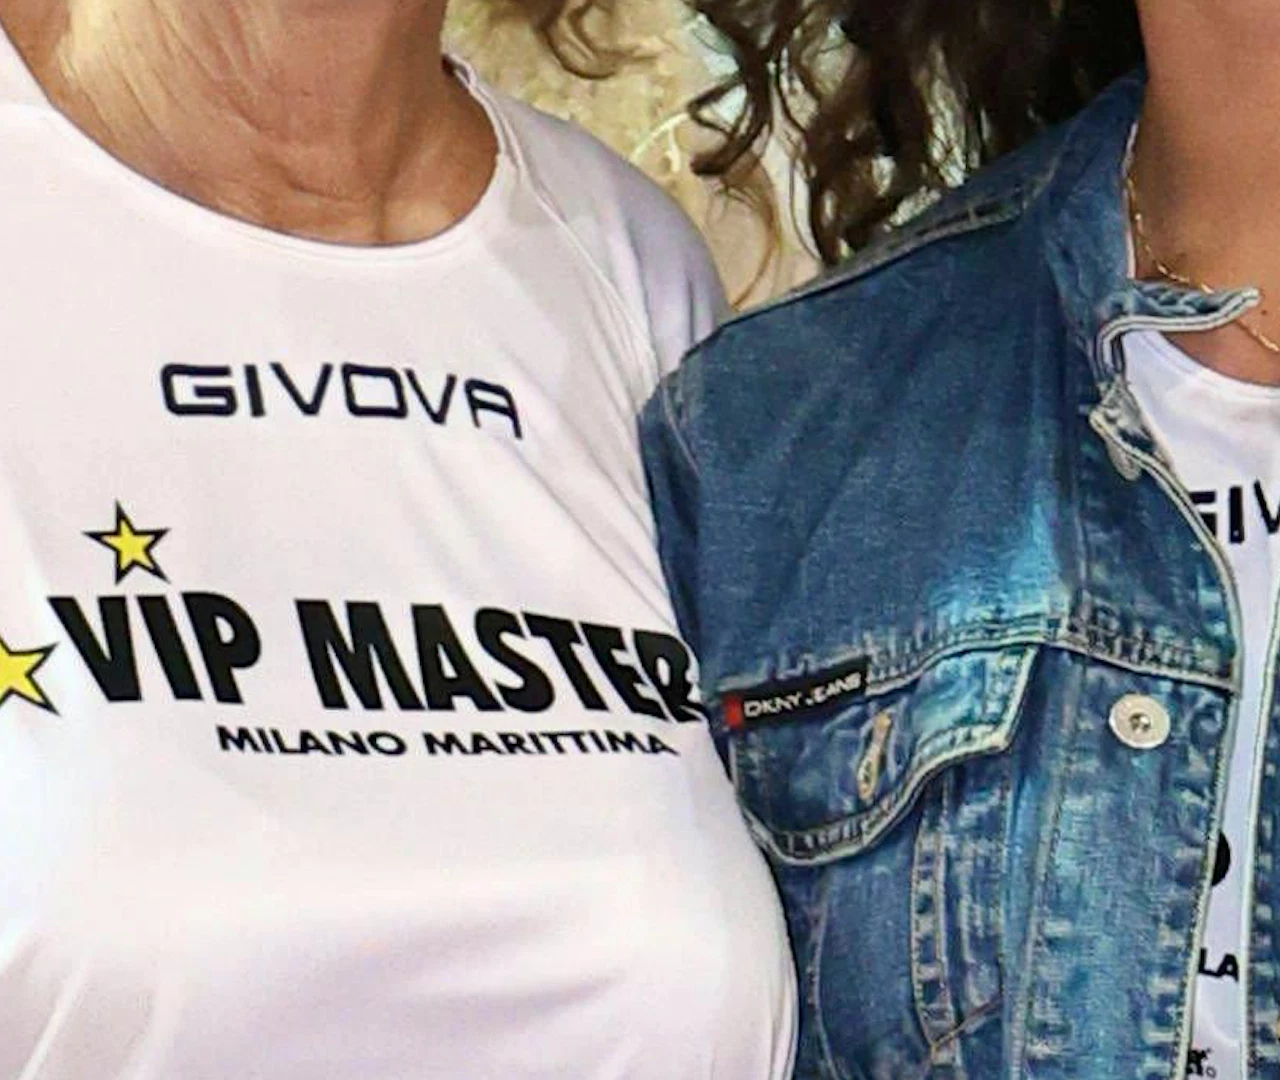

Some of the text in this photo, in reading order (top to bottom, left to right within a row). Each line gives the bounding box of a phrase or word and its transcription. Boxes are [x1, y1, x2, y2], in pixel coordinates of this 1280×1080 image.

[160, 362, 523, 440] GIVOVA
[48, 591, 708, 723] VIP MASTER
[743, 692, 802, 717] DKNY
[216, 725, 680, 757] MILANO MARITTIMA
